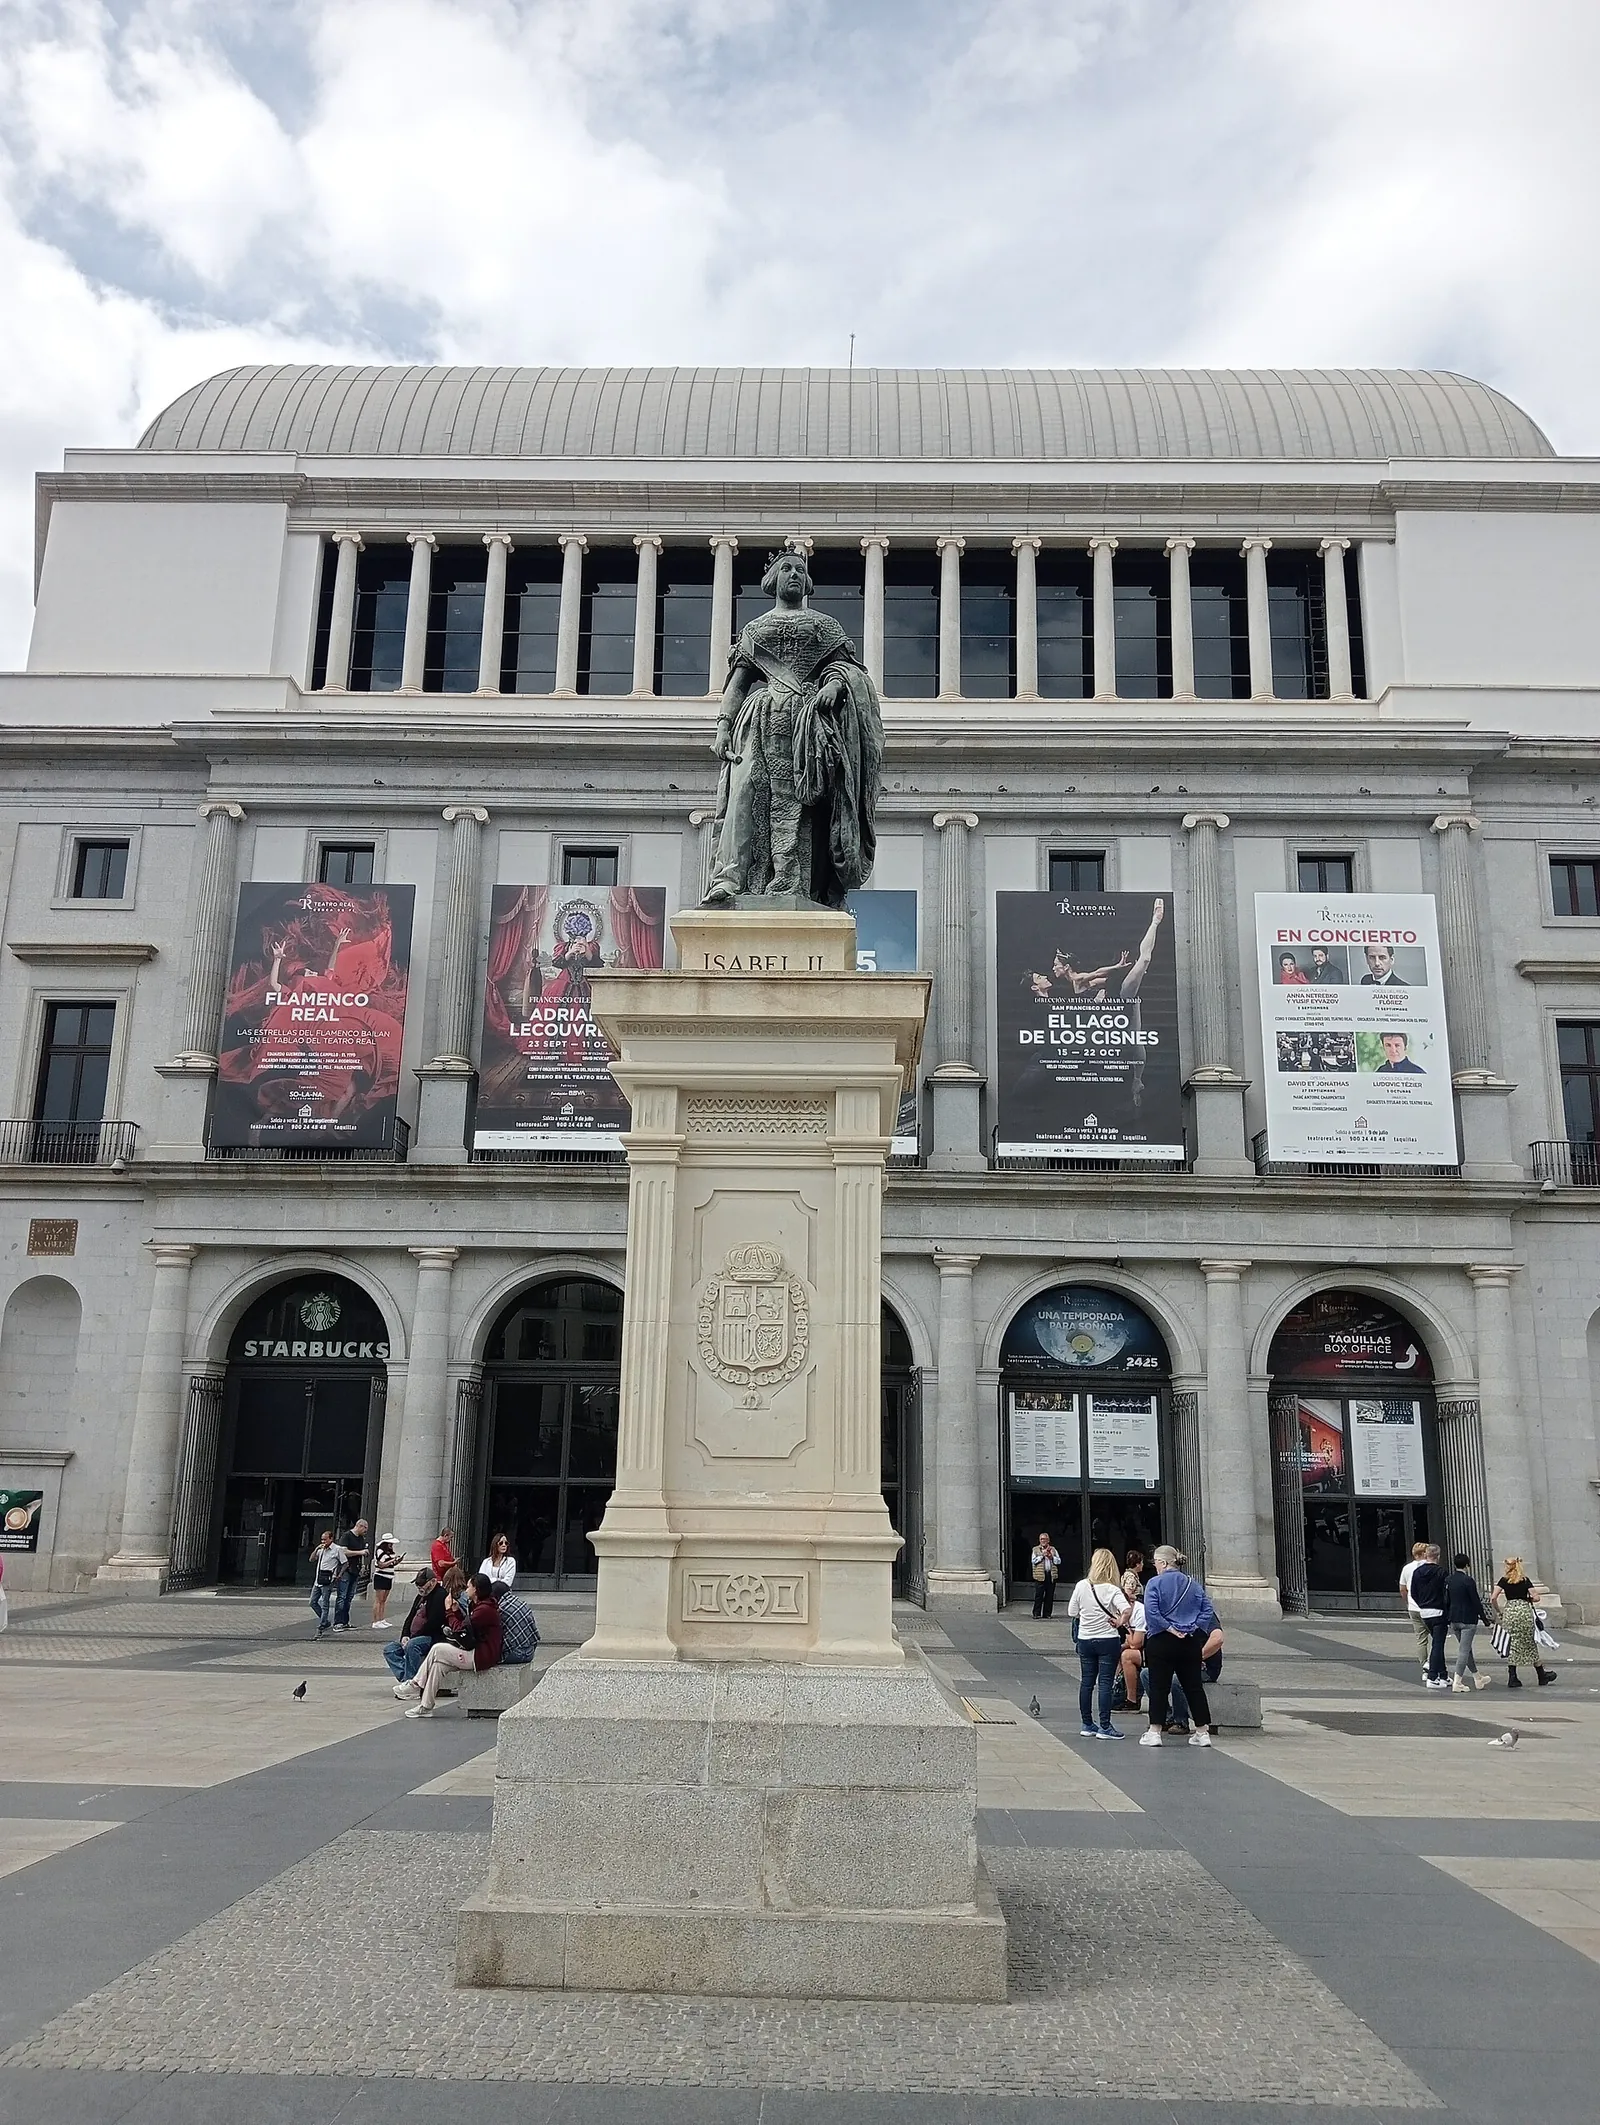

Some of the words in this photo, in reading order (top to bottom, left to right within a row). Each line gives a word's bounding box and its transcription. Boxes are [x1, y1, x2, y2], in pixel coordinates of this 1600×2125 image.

[1277, 930, 1301, 942] EN
[1308, 930, 1417, 943] CONCIERTO
[704, 953, 788, 970] ISABEL
[808, 955, 823, 970] II
[265, 992, 369, 1006] FLAMENCO
[291, 1008, 340, 1021] REAL
[530, 1008, 592, 1021] ADRIA
[1048, 1014, 1071, 1028] EL
[1076, 1014, 1129, 1028] LAGO
[1020, 1030, 1045, 1044] DE
[1050, 1030, 1086, 1044] LOS
[1091, 1031, 1159, 1045] CISNES
[1062, 1312, 1124, 1321] TEMPORADA
[1050, 1321, 1076, 1330] PARA
[1078, 1321, 1114, 1330] SOÑAR
[1329, 1335, 1391, 1344] TAQUILLAS
[244, 1340, 389, 1358] STARBUCKS
[1324, 1344, 1347, 1354] BOX
[1351, 1344, 1392, 1354] OFFICE
